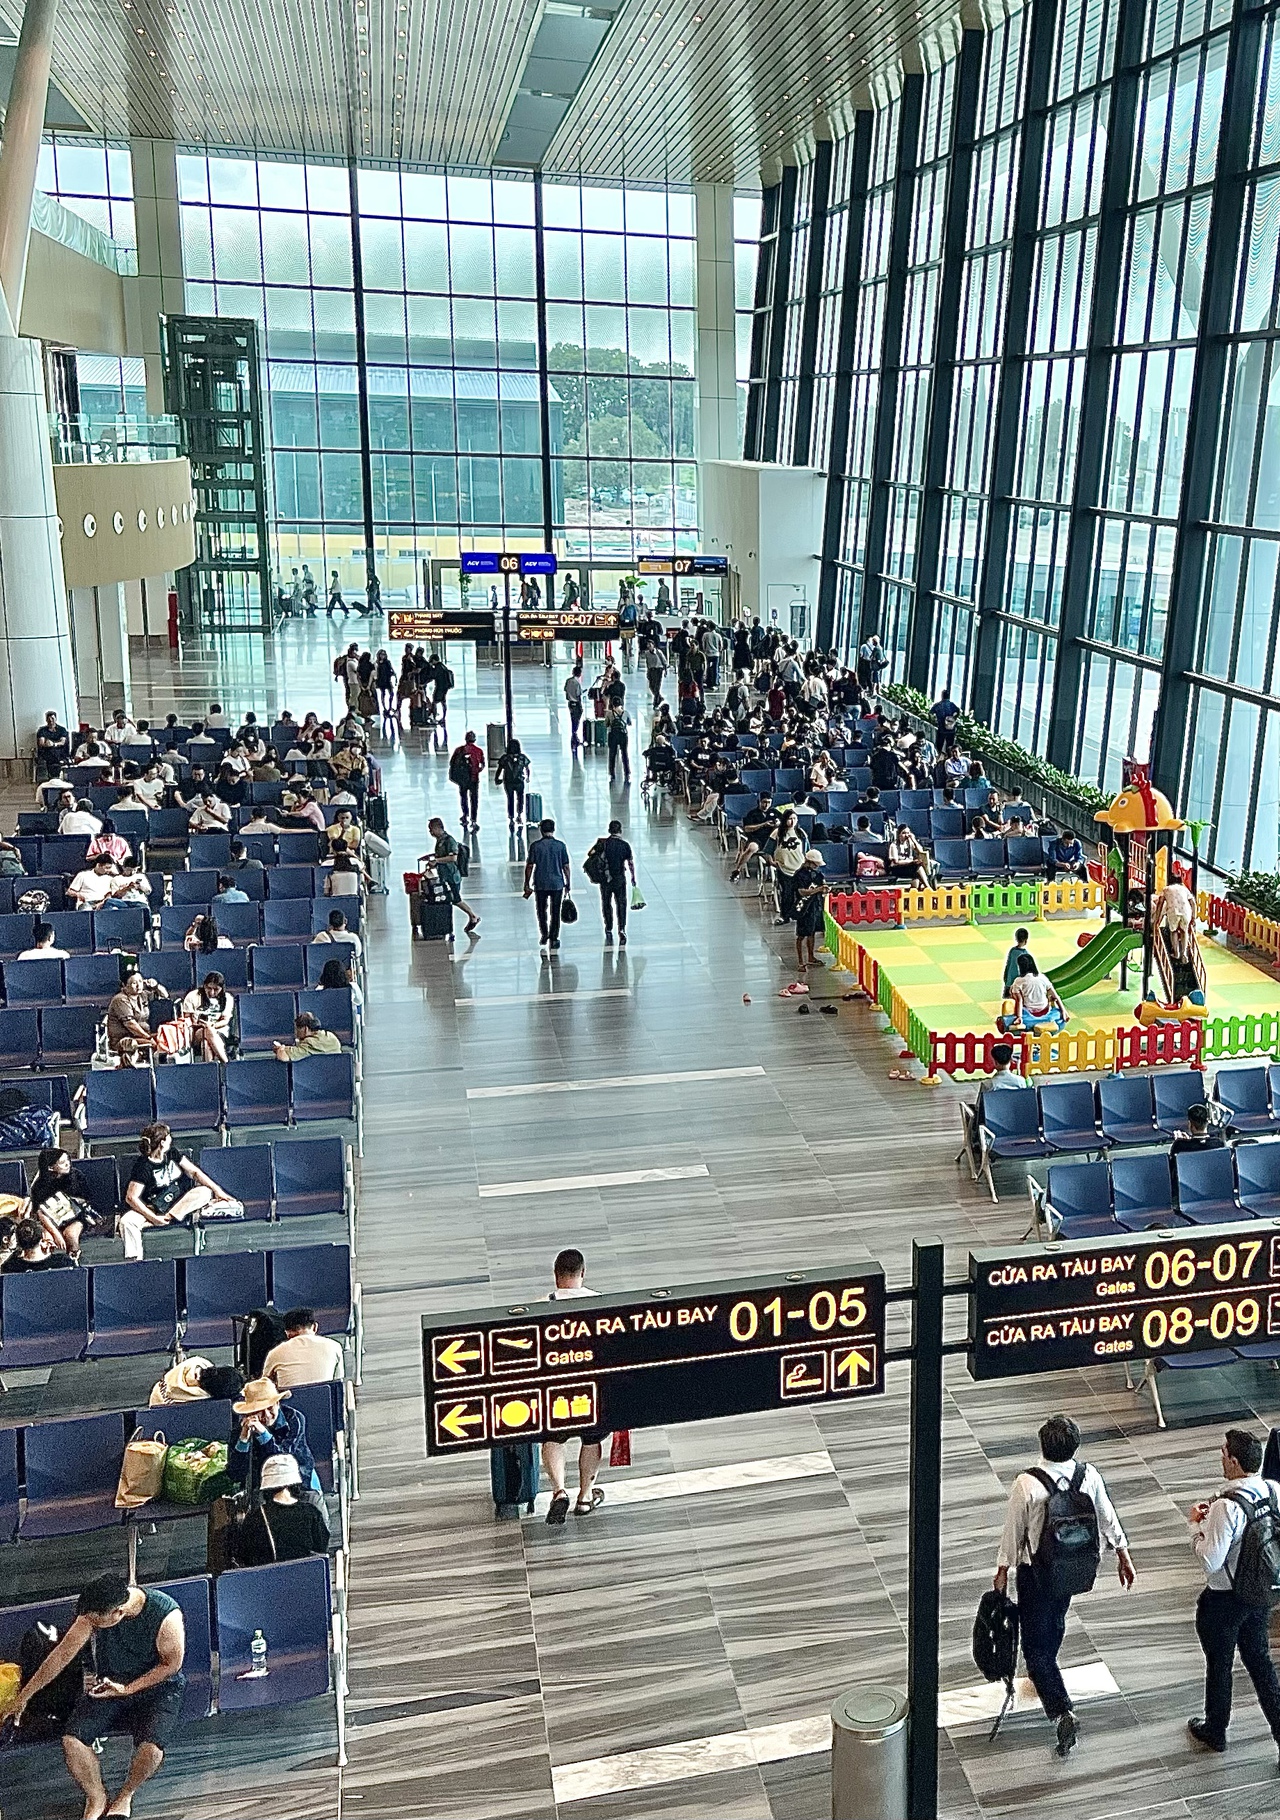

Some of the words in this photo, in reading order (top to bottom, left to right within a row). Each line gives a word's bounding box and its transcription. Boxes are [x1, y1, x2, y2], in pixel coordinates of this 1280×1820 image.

[500, 557, 518, 570] 06
[674, 560, 691, 572] 07
[560, 614, 593, 625] 06-07
[989, 1265, 1028, 1286] CỬA
[1033, 1264, 1058, 1282] RA
[1061, 1258, 1097, 1278] TÀU
[1101, 1255, 1137, 1274] BAY
[1145, 1241, 1263, 1290] 06-07
[1097, 1281, 1136, 1297] Gates
[545, 1319, 592, 1342] CỬA
[597, 1317, 626, 1336] RA
[630, 1310, 672, 1331] TÀU
[678, 1305, 719, 1325] BAY
[729, 1287, 867, 1342] 01-05
[987, 1325, 1027, 1347] CỬA
[1031, 1323, 1056, 1342] RA
[1060, 1317, 1096, 1337] TÀU
[1099, 1313, 1135, 1333] BAY
[1142, 1299, 1260, 1348] 08-09
[1094, 1340, 1134, 1355] Gates
[545, 1350, 594, 1367] Gates
